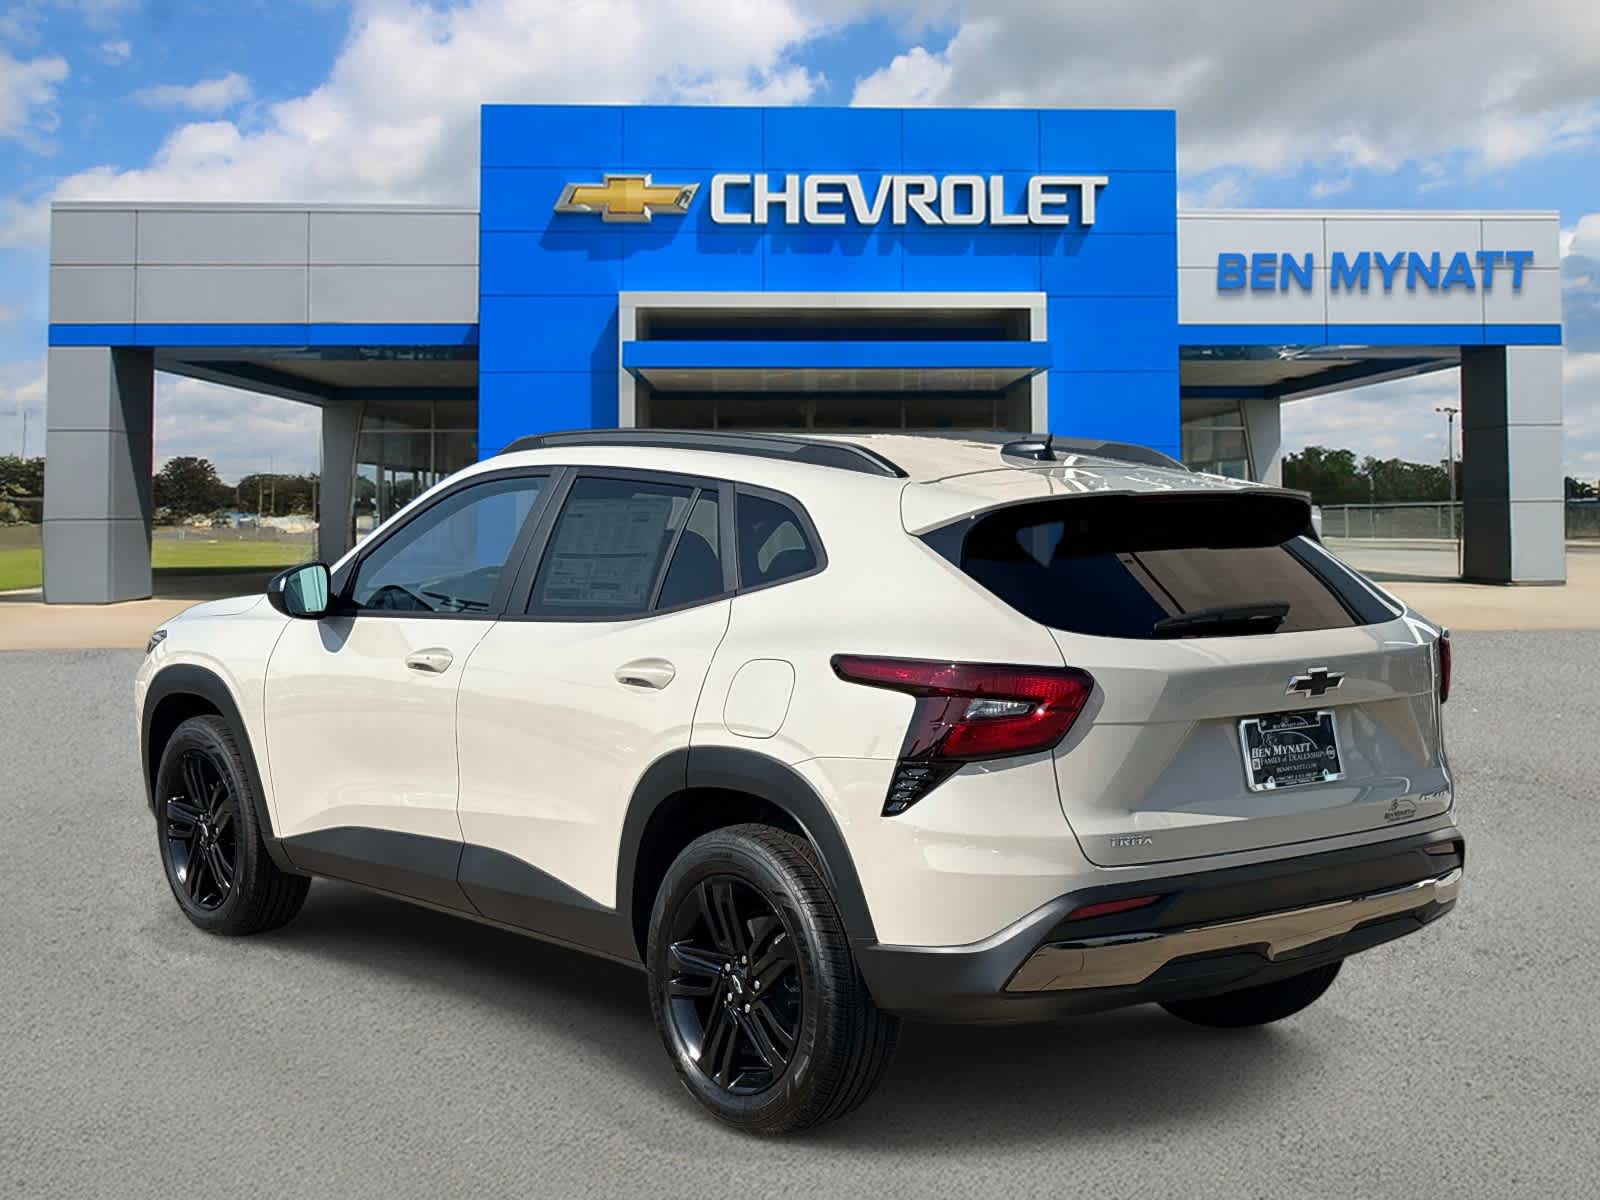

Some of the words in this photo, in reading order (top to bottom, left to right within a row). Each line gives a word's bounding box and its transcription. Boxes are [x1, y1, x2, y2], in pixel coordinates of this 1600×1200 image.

[710, 173, 1110, 226] CHEVROLET
[1217, 251, 1314, 291] BEN
[1329, 249, 1535, 291] MYNATT
[1273, 742, 1311, 755] MYNATT
